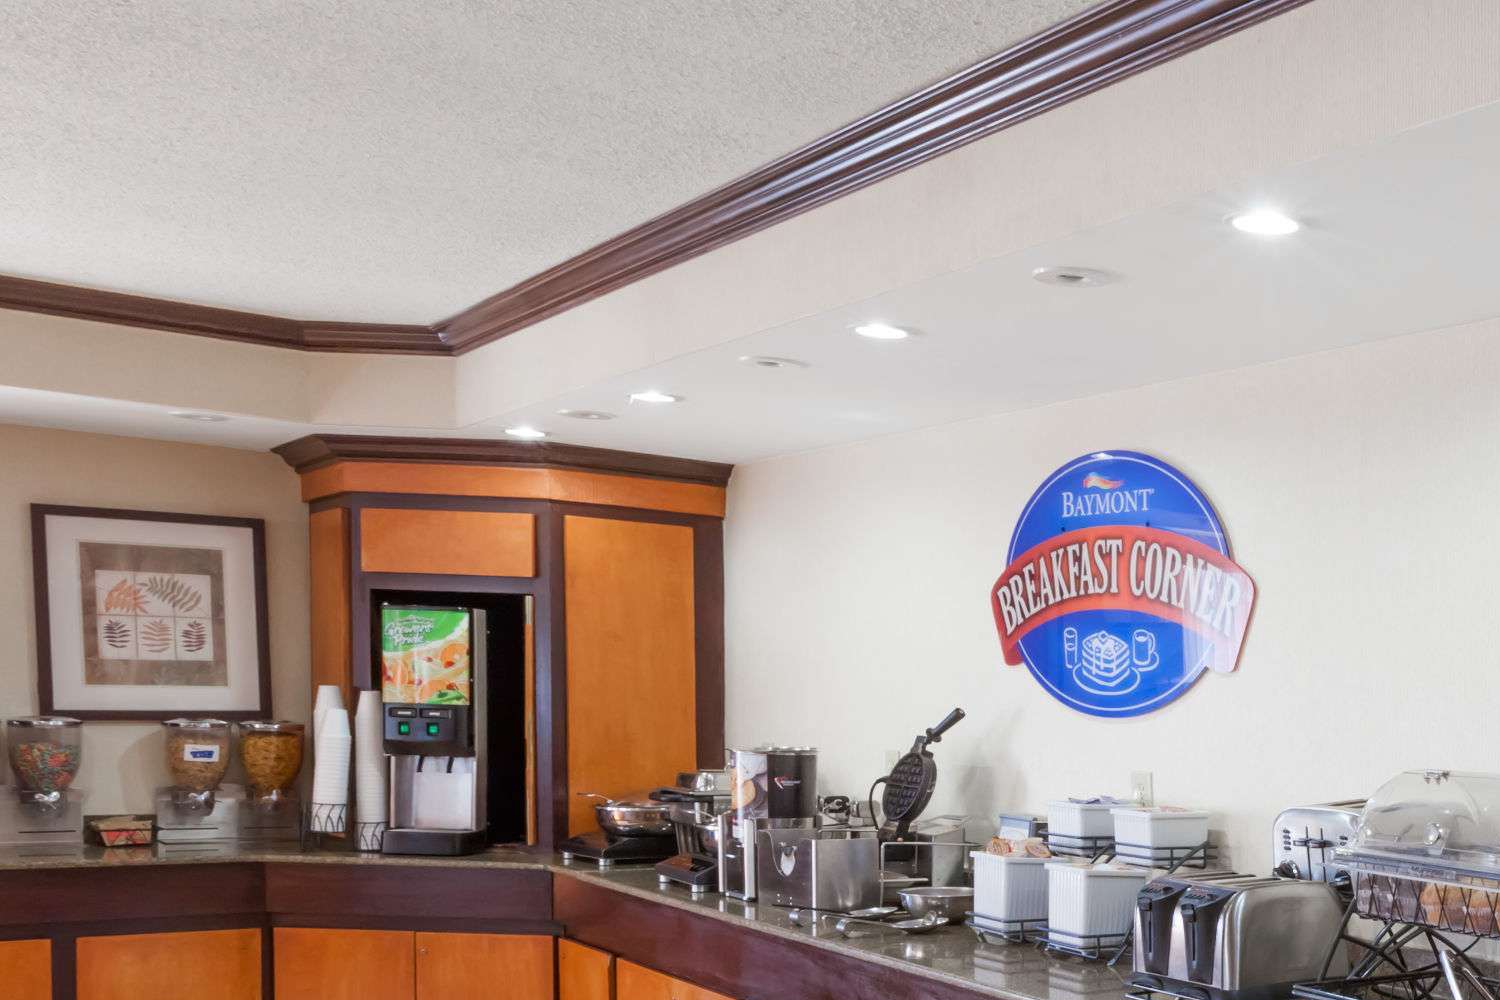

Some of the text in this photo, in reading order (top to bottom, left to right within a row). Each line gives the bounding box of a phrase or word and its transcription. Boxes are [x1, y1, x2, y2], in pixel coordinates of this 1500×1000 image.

[1061, 488, 1151, 518] BAYMONT
[996, 538, 1241, 637] BREAKFAST CORNER
